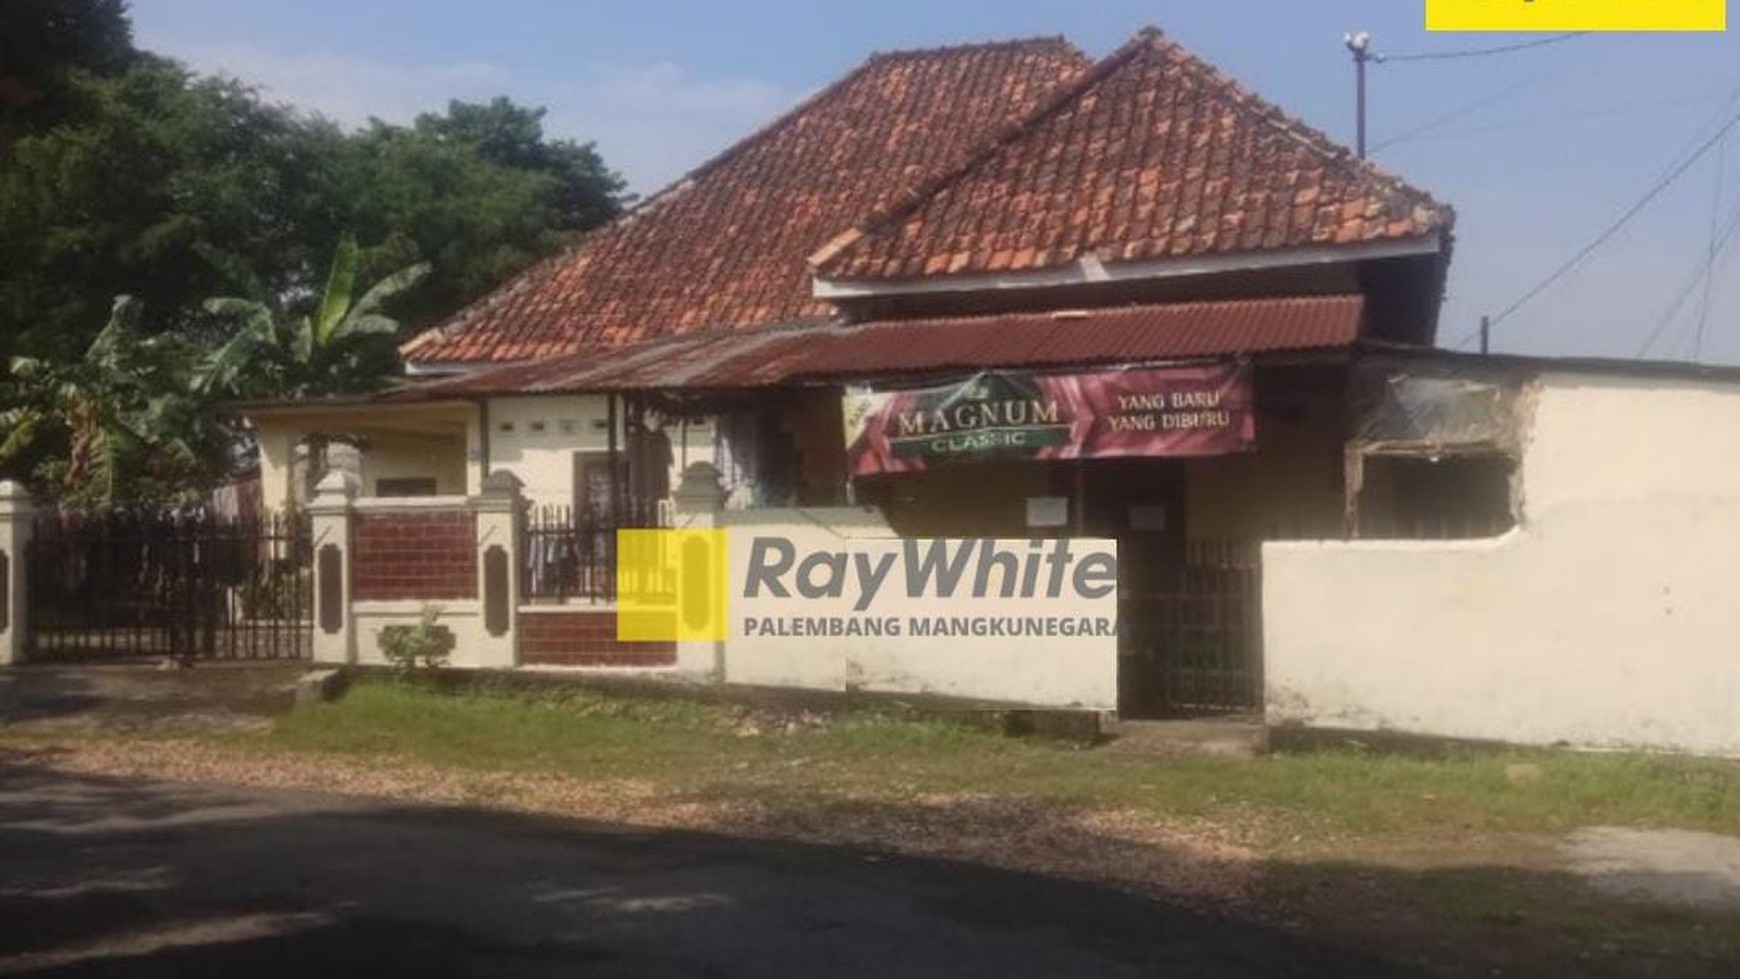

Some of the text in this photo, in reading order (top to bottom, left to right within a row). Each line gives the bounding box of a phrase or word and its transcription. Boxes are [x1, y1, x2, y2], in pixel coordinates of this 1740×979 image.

[1118, 391, 1220, 410] YANG BARU
[897, 400, 1060, 434] MAGNUM
[1107, 411, 1231, 432] YANG DIBURU
[931, 431, 1026, 452] CLASSIC
